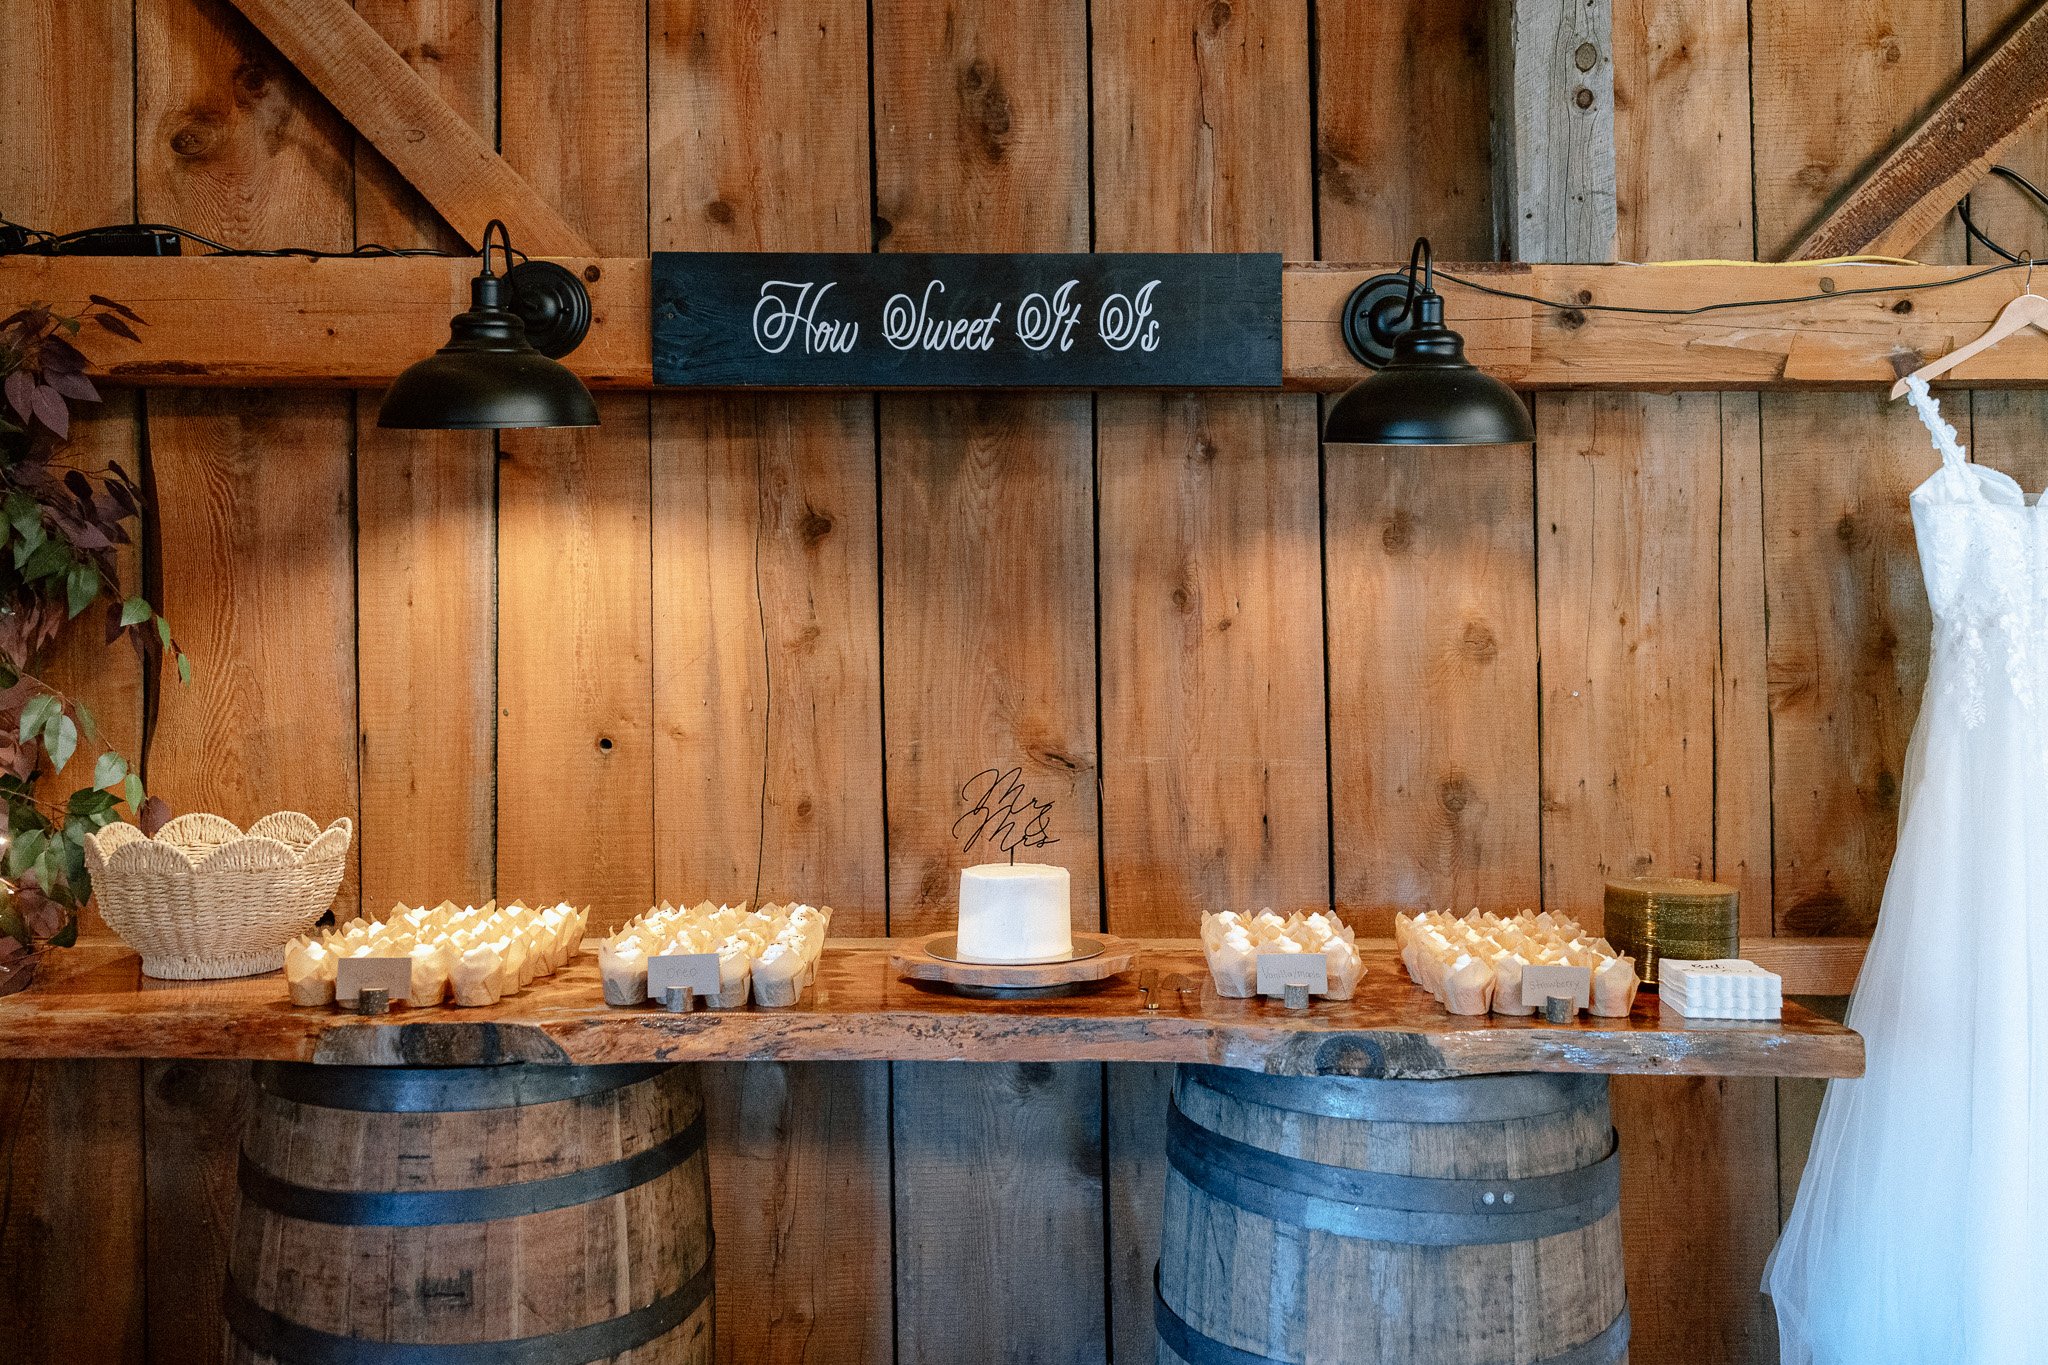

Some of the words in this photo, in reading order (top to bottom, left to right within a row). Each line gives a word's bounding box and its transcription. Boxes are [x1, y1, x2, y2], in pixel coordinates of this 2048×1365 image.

[752, 279, 859, 354] How
[881, 279, 1002, 352] Sweet
[1015, 279, 1081, 352] It
[1098, 279, 1163, 353] Is
[962, 767, 1055, 815] Mr
[952, 804, 1061, 853] Mrs
[666, 967, 698, 979] Oreo
